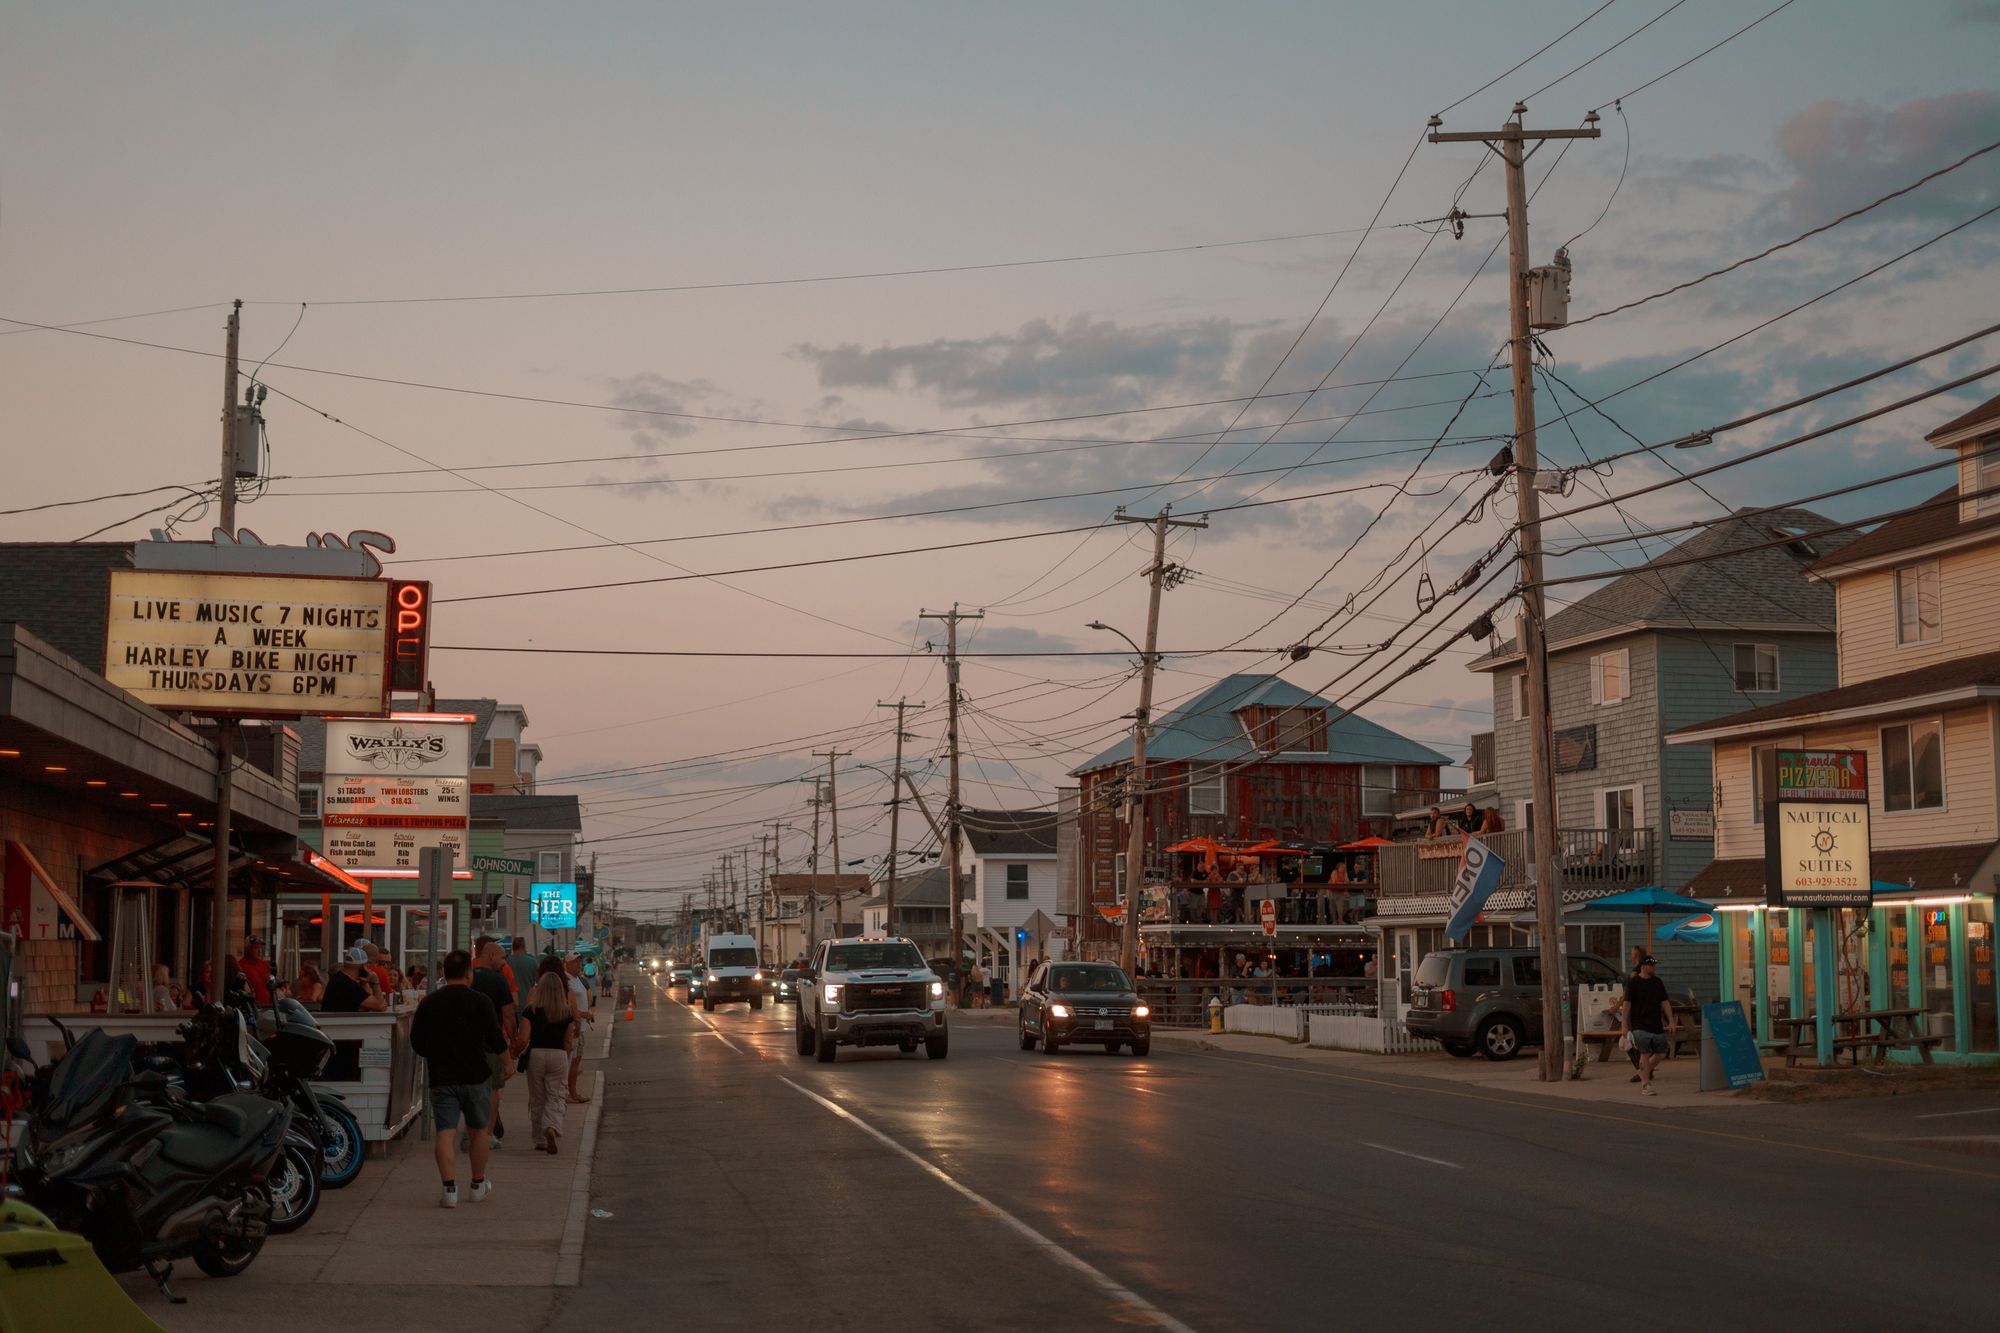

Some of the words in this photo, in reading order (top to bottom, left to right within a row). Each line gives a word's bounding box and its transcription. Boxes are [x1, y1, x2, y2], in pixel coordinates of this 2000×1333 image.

[133, 600, 180, 620] LIVE
[196, 603, 262, 624] MUSIC
[280, 606, 291, 624] 7
[302, 607, 379, 628] NIGHTS
[214, 627, 227, 645] A
[253, 628, 307, 648] WEEK
[125, 646, 209, 668] HARLEY
[231, 650, 280, 670] BIKE
[294, 653, 357, 673] NIGHT
[149, 670, 271, 692] THURSDAYS
[293, 675, 336, 695] 6PM
[350, 735, 444, 752] WALLY'S
[1779, 767, 1850, 788] PIZZERIA
[346, 787, 366, 795] TACOS
[381, 788, 398, 796] TWIN
[399, 788, 429, 796] LOBSTERS
[1840, 790, 1864, 799] PIZZA
[326, 796, 336, 804] $5
[337, 796, 376, 804] MARGARITAS
[438, 795, 460, 803] WINGS
[328, 814, 364, 825] Thursday
[1786, 811, 1861, 824] NAUTICAL
[330, 840, 340, 848] All
[340, 840, 352, 848] You
[352, 840, 366, 848] Can
[366, 840, 376, 848] Eat
[393, 840, 414, 848] Prime
[438, 841, 461, 850] Turkey
[329, 849, 344, 857] Fish
[344, 849, 358, 857] and
[358, 849, 376, 858] Chips
[398, 849, 410, 857] Rib
[346, 857, 359, 865] $12
[473, 858, 521, 873] JOHNSON
[1799, 860, 1852, 872] SUITES
[1795, 877, 1858, 887] 603-929-3522
[542, 890, 561, 898] THE
[1786, 893, 1869, 902] www.nauticalmotel.com
[531, 899, 575, 915] PIER
